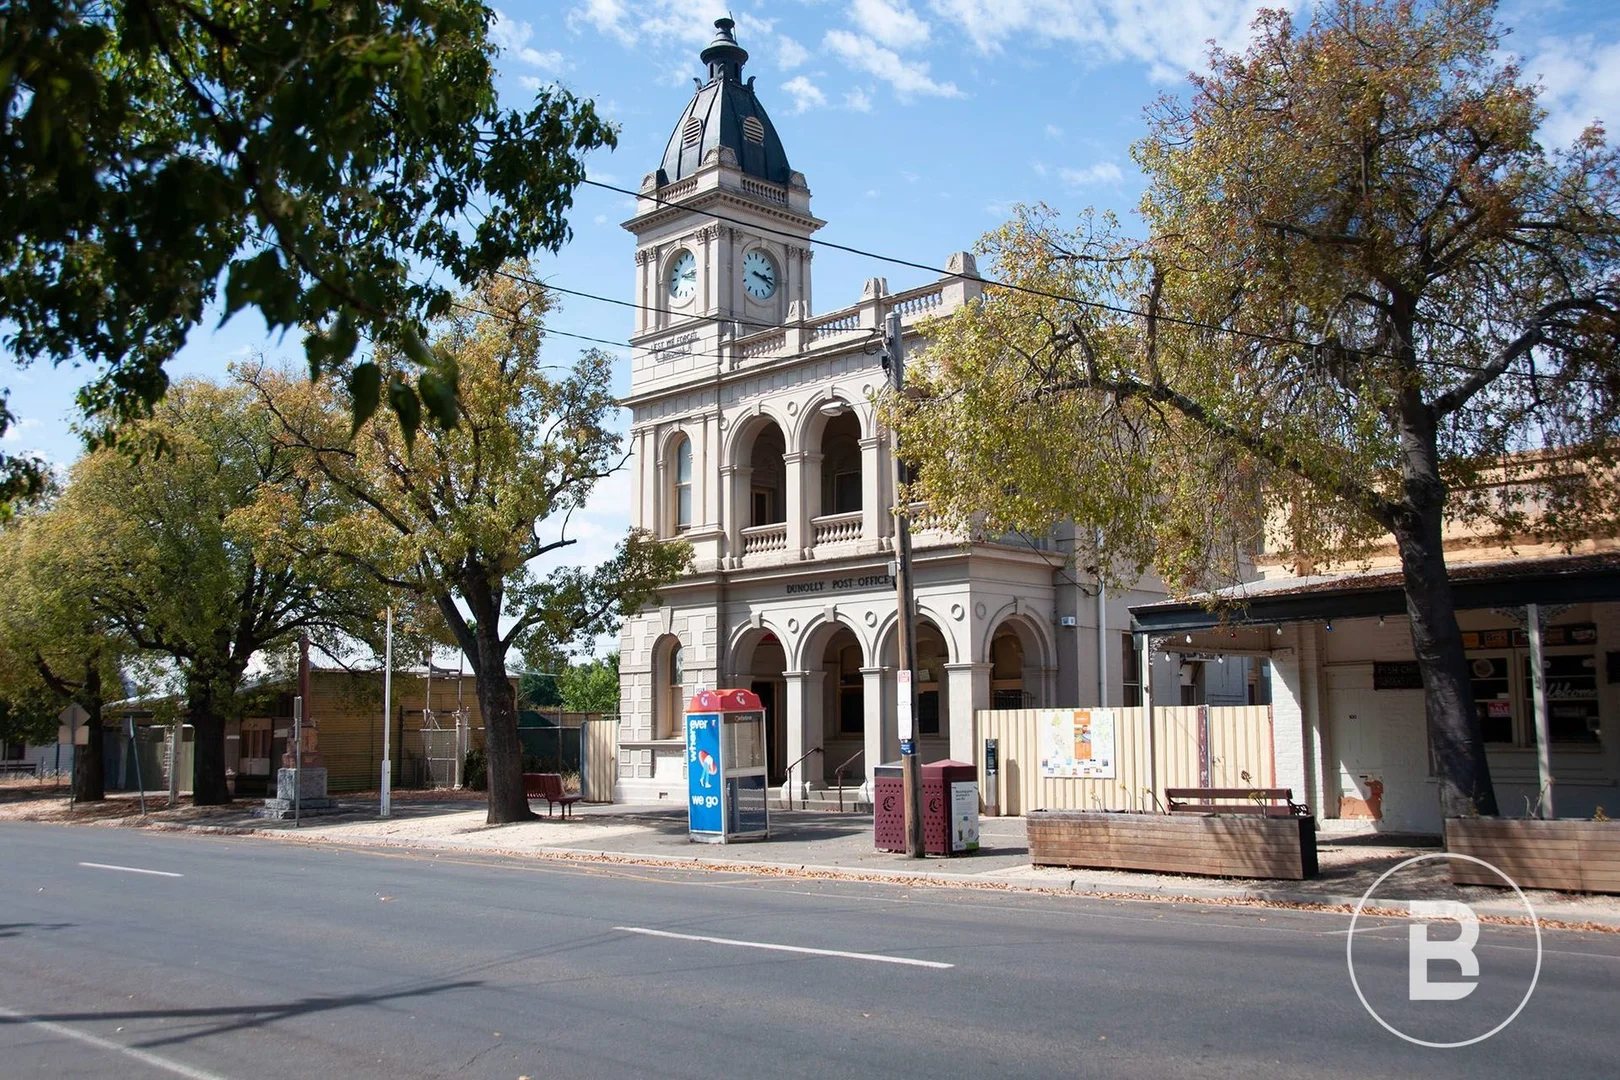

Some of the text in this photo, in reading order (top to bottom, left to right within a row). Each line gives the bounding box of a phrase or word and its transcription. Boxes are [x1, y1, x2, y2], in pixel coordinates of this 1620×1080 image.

[786, 574, 890, 594] DUNOLLY POST OFFICE
[692, 796, 719, 808] we go
